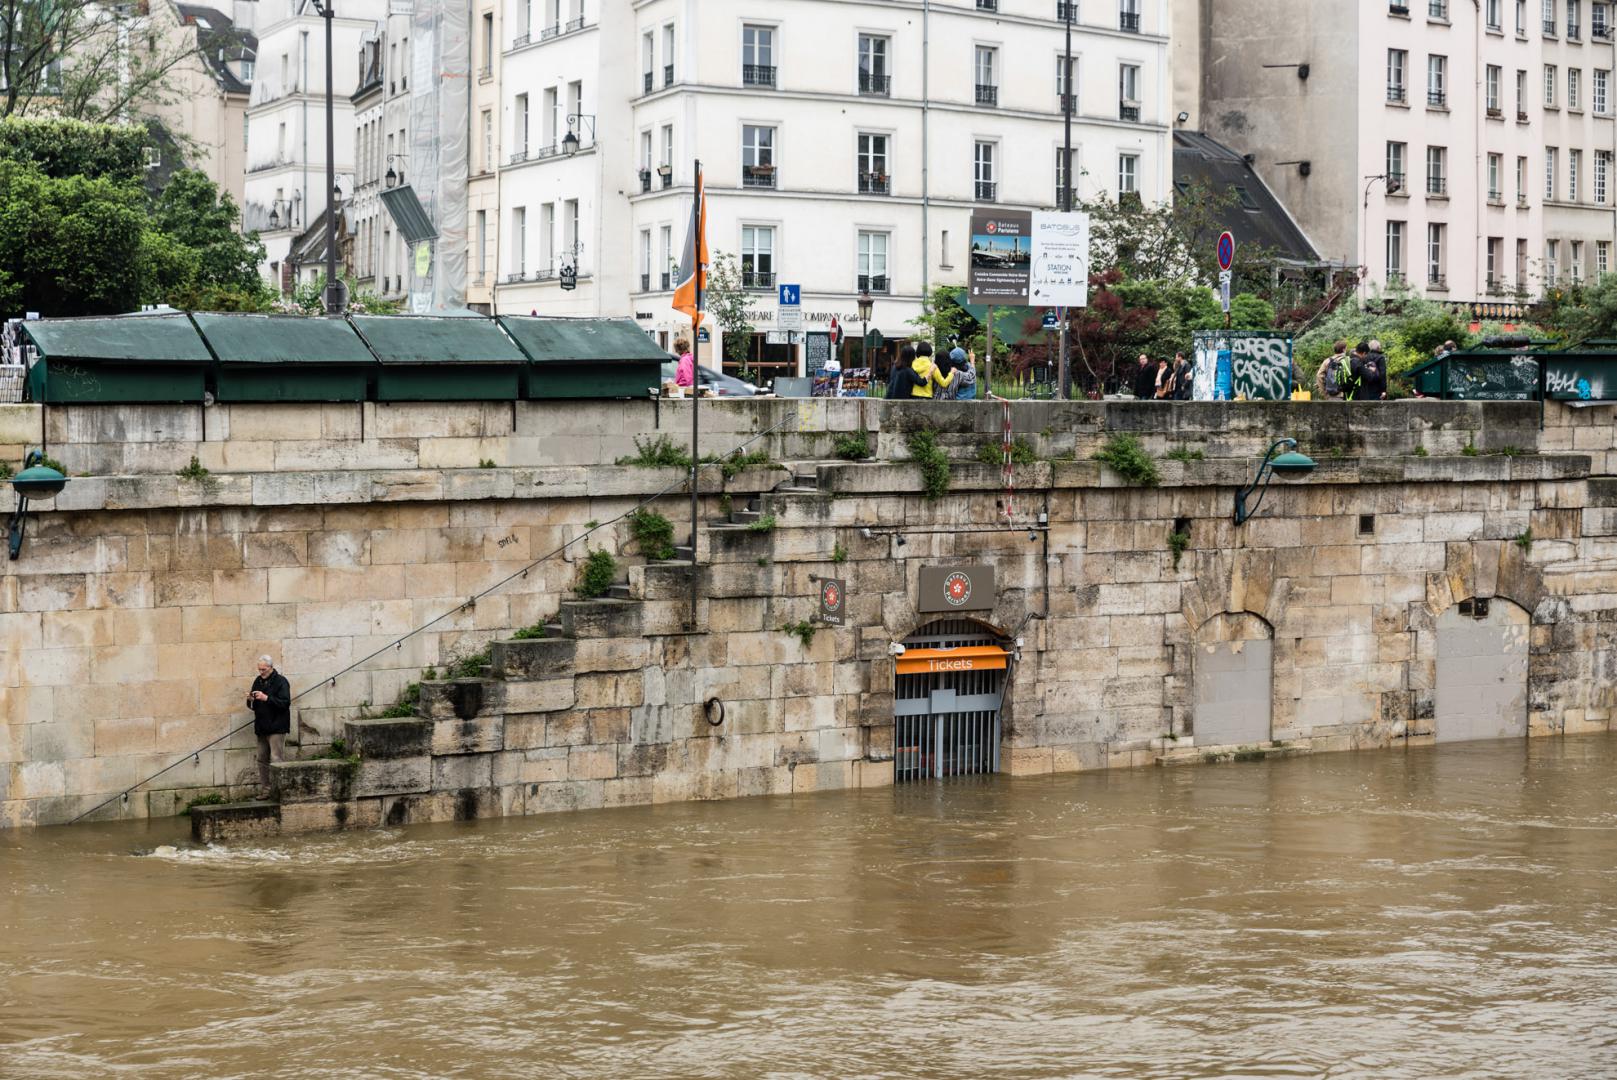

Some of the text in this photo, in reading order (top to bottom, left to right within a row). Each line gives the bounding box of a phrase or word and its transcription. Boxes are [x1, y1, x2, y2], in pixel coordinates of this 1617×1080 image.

[1040, 223, 1080, 231] BATOBUS
[1047, 263, 1072, 271] STATION
[823, 613, 840, 623] Tickets
[927, 658, 973, 671] Tickets
